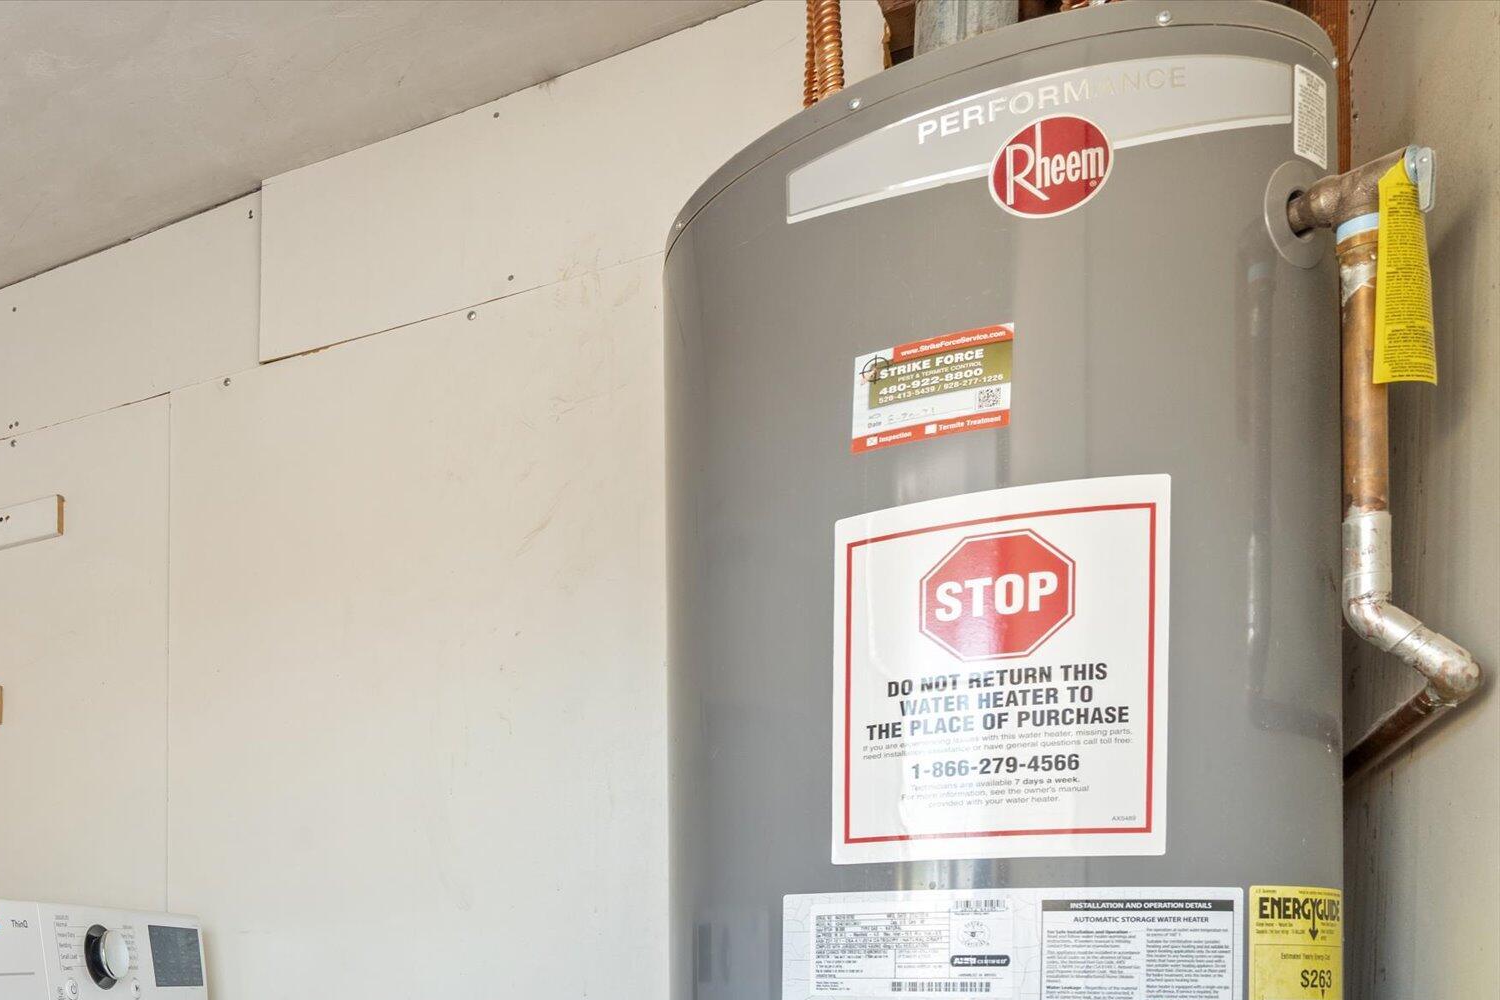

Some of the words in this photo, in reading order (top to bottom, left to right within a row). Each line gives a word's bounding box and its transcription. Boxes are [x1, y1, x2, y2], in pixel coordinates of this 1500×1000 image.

[918, 66, 1186, 144] PERFORMANCE
[1006, 120, 1104, 206] Rheem
[879, 359, 931, 379] STRIKE
[935, 349, 984, 366] FORCE
[879, 368, 983, 396] 480-922-8800
[935, 570, 1058, 623] STOP
[887, 679, 913, 697] DO
[920, 674, 960, 692] NOT
[968, 666, 1052, 689] RETURN
[1061, 663, 1108, 681] THIS
[900, 695, 969, 716] WATER
[978, 688, 1058, 710] HEATER
[1067, 685, 1093, 703] TO
[867, 722, 902, 740] THE
[910, 715, 974, 736] PLACE
[982, 713, 1008, 730] OF
[1017, 706, 1129, 728] PURCHASE
[912, 753, 1080, 780] 1-866-279-4566
[11, 920, 28, 929] ThinQ
[1301, 969, 1332, 989] $263
